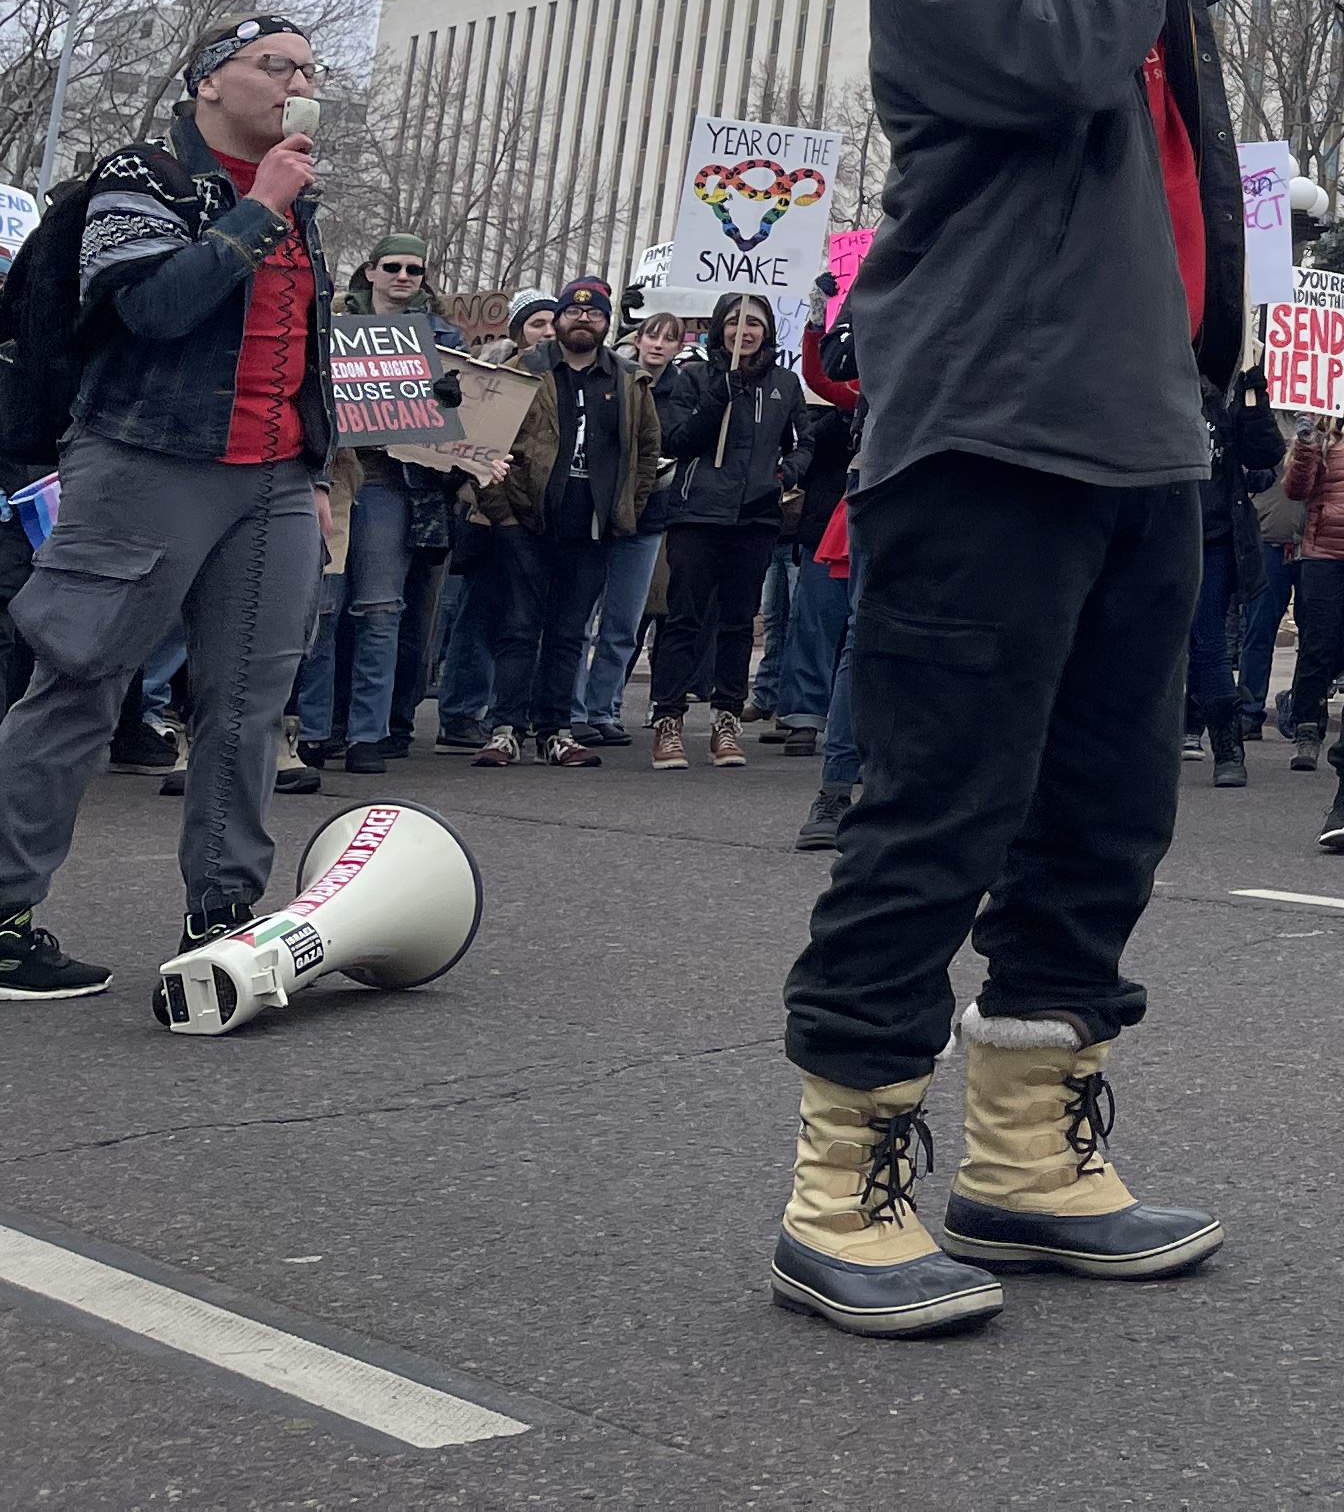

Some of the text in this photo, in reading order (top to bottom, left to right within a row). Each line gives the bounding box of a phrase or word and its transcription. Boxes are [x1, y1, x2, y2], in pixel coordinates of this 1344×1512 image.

[707, 123, 835, 165] YEAR OF THE
[0, 193, 33, 213] END
[1244, 193, 1285, 229] ECT
[697, 251, 788, 286] SNAKE
[453, 294, 509, 326] NO
[1294, 288, 1327, 308] DING
[330, 326, 421, 356] MEN
[331, 359, 424, 379] EDOM & RIGHTS
[1267, 351, 1343, 410] HELP.
[333, 380, 431, 400] AUSE OF
[337, 399, 445, 433] UBLICANS
[352, 810, 397, 848] SPACE
[339, 849, 374, 863] IN
[305, 864, 361, 903] WEAPONS
[285, 926, 315, 946] ISRAEL
[296, 946, 322, 969] GAZA
